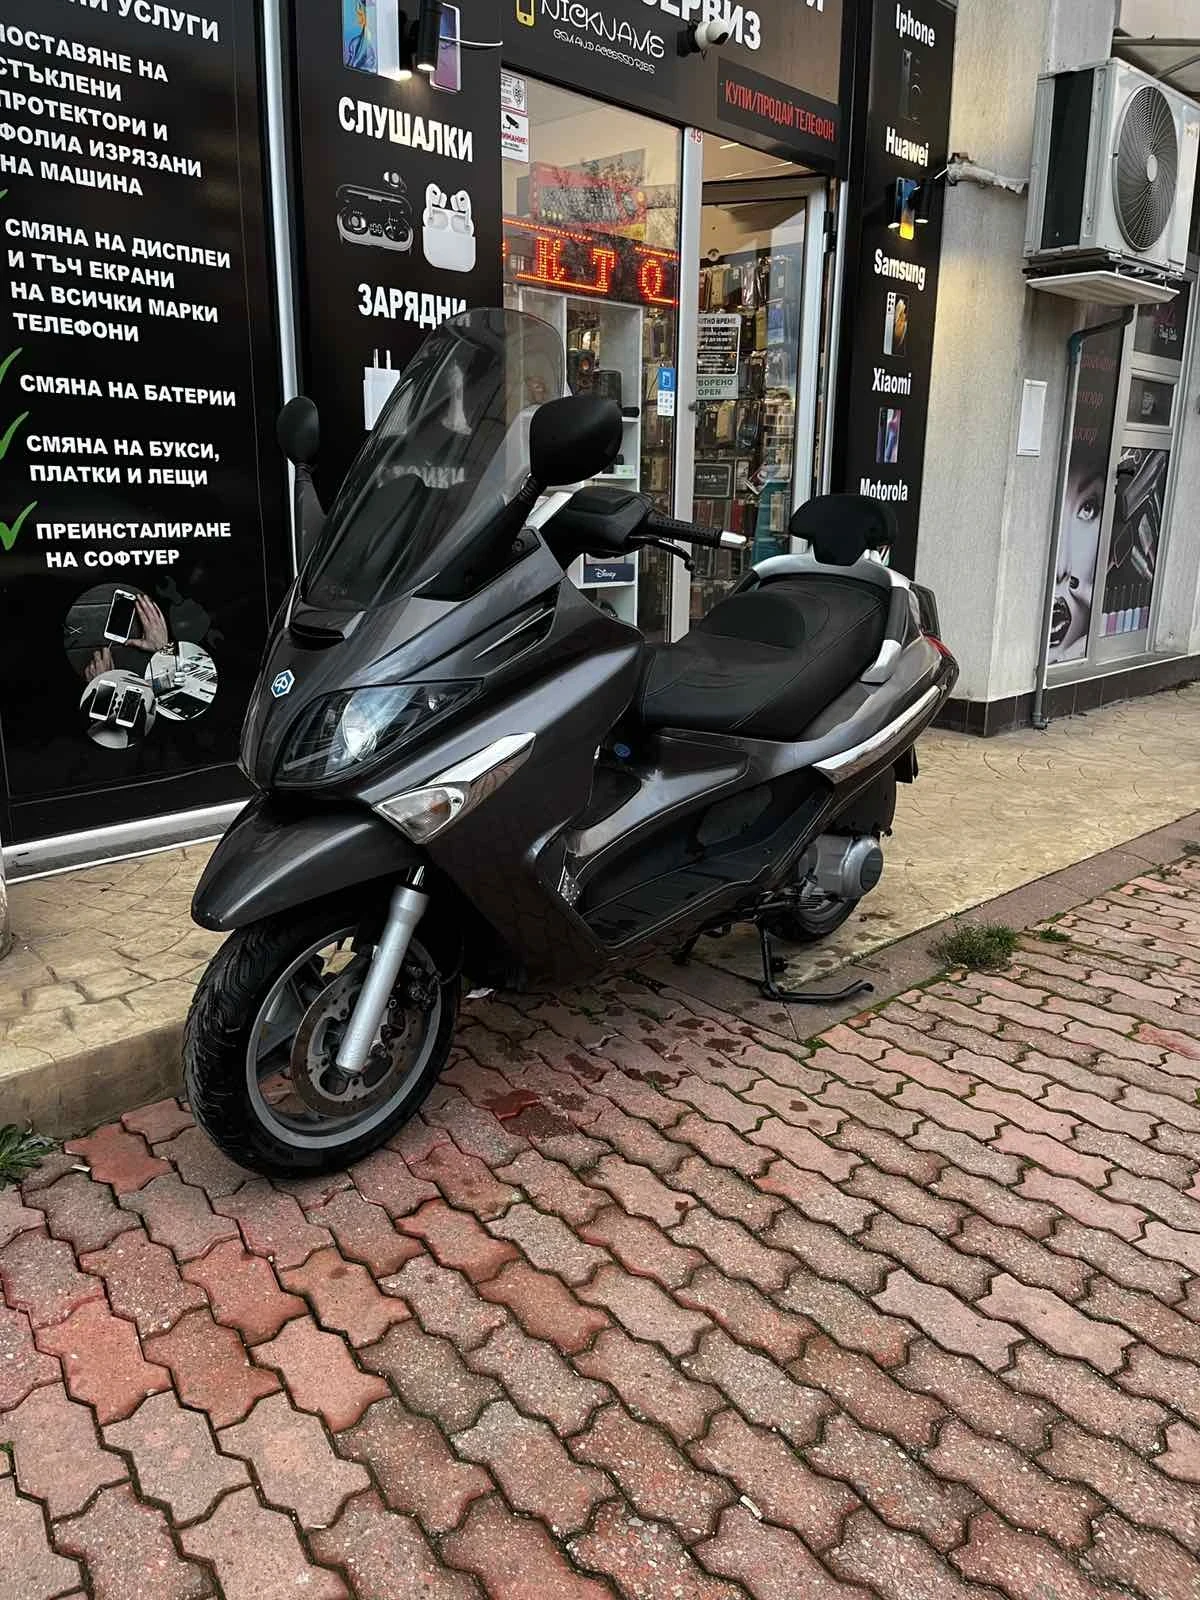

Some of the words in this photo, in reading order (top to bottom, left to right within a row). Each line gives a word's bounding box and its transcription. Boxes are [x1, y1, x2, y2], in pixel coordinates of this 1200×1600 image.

[118, 0, 219, 42] УСЛУГИ
[541, 0, 665, 58] NICKNAME
[641, 0, 761, 50] РВИЗ
[896, 3, 935, 47] Iphone
[138, 59, 169, 83] НА
[0, 90, 146, 137] ПРОТЕКТОРИ
[153, 122, 168, 141] И
[338, 96, 473, 162] СЛУШАЛКИ
[794, 108, 835, 142] ТЕЛЕФОН
[0, 122, 83, 155] ФОЛИА
[89, 139, 202, 178] ИЗРЯЗАНИ
[886, 126, 929, 167] Huawei
[0, 154, 34, 176] НА
[40, 160, 143, 196] МАШИНА
[5, 218, 89, 247] СМЯНА
[95, 231, 126, 253] НА
[132, 237, 231, 269] ДИСПЛЕИ
[7, 249, 25, 269] И
[31, 252, 82, 276] ТЪЧ
[89, 260, 175, 289] ЕКРАНИ
[873, 248, 926, 291] Samsung
[10, 281, 44, 302] НА
[51, 286, 142, 314] ВСИЧКИ
[148, 298, 218, 323] МАРКИ
[358, 283, 467, 330] ЗАРЯДНИ
[12, 312, 139, 342] ТЕЛЕФОНИ
[20, 374, 103, 397] СМЯНА
[108, 381, 139, 400] НА
[144, 384, 236, 407] БАТЕРИИ
[697, 388, 721, 396] OPEN
[872, 367, 912, 395] Xiaomi
[26, 435, 108, 456] СМЯНА
[113, 439, 143, 457] НА
[149, 440, 220, 462] БУКСИ,
[30, 465, 121, 483] ПЛАТКИ
[127, 468, 142, 484] И
[148, 468, 208, 487] ЛЕЩИ
[860, 478, 908, 501] Motorola
[36, 522, 232, 539] ПРЕИНСТАЛИРАНЕ
[46, 552, 77, 568] НА
[84, 549, 180, 567] СОФТУЕР
[594, 567, 616, 579] Disney
